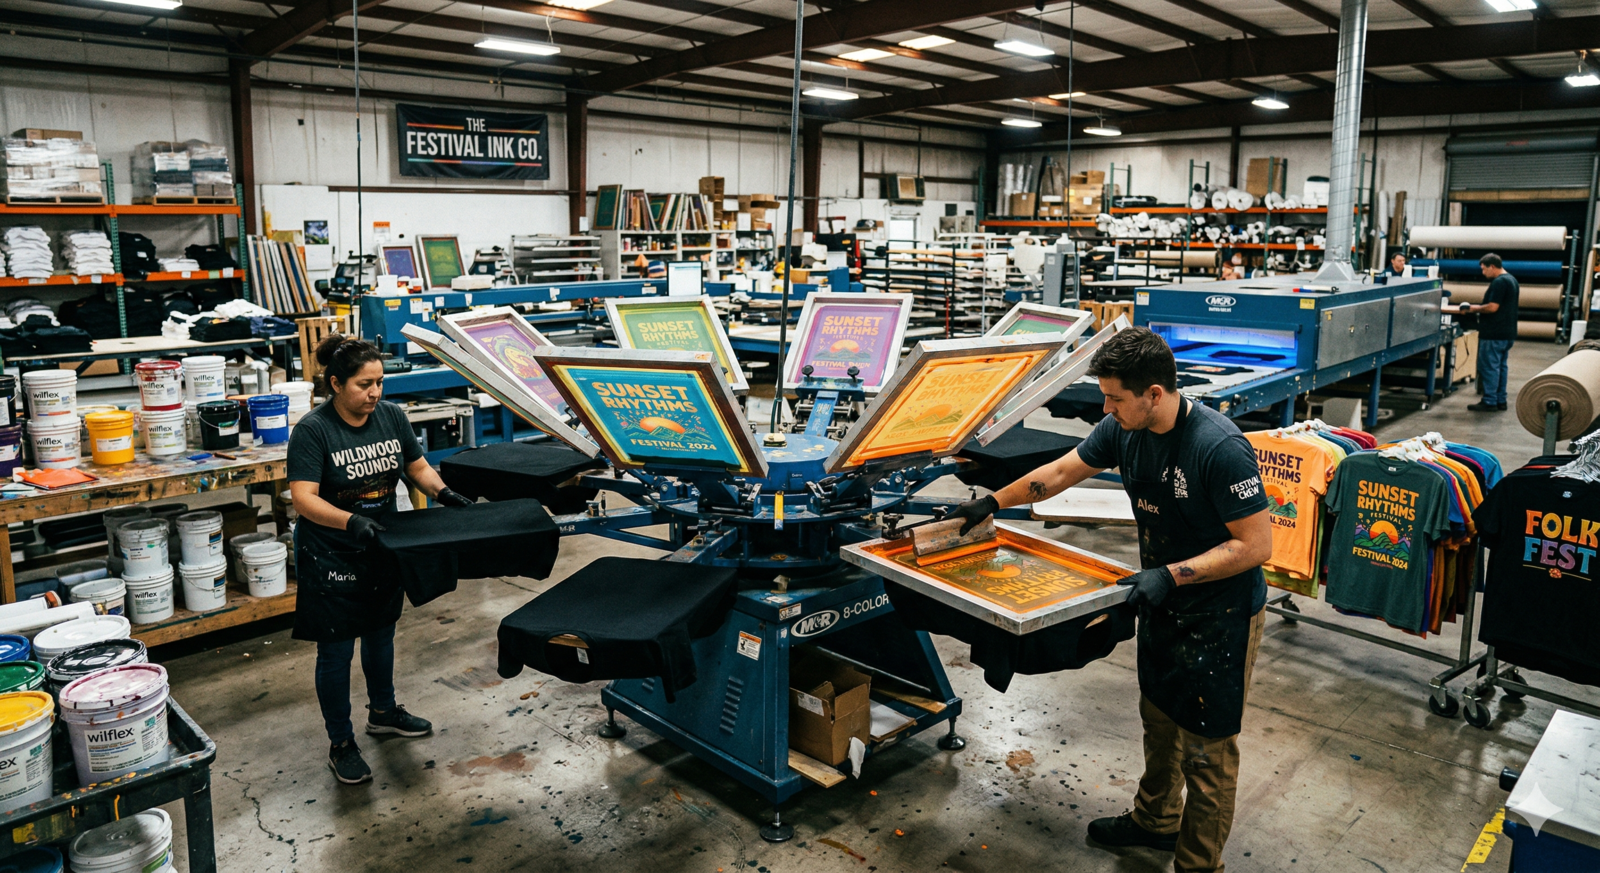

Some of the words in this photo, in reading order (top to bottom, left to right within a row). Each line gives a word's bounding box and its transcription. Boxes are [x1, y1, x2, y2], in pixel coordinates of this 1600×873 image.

[466, 117, 486, 132] THE
[406, 131, 484, 157] FESTIVAL
[487, 135, 515, 159] INK
[518, 138, 542, 160] CO.
[637, 320, 694, 333] SUNSET
[823, 316, 883, 327] SUNSET
[641, 330, 699, 342] RHYTHMS
[821, 325, 879, 336] RHYTHMS
[925, 371, 1001, 389] SUNSET
[32, 391, 59, 399] wilflex
[591, 382, 689, 400] SUNSET
[601, 396, 698, 413] RHYTHMS
[331, 438, 402, 467] WILDWOOD
[630, 438, 686, 449] FESTIVAL
[687, 442, 717, 451] 2024
[346, 455, 399, 480] SOUNDS
[1253, 448, 1303, 470] SUNSET
[1258, 464, 1302, 483] HYTHMS
[1262, 477, 1288, 488] ESTIVAL
[1358, 479, 1420, 507] SUNSET
[1137, 498, 1160, 515] Alex
[1357, 495, 1416, 521] RHYTHMS
[1279, 517, 1296, 529] 2024
[1370, 512, 1402, 525] FESTIVAL
[1525, 509, 1600, 548] FOLK
[1352, 546, 1391, 563] FESTIVAL
[1391, 557, 1408, 570] 2024
[1523, 536, 1597, 575] FEST
[328, 571, 357, 582] Maria
[134, 591, 157, 599] wilflex
[1006, 576, 1088, 605] SUNSET
[800, 612, 832, 634] M&R
[843, 593, 889, 619] 8-COLOR
[87, 727, 134, 743] wilflex
